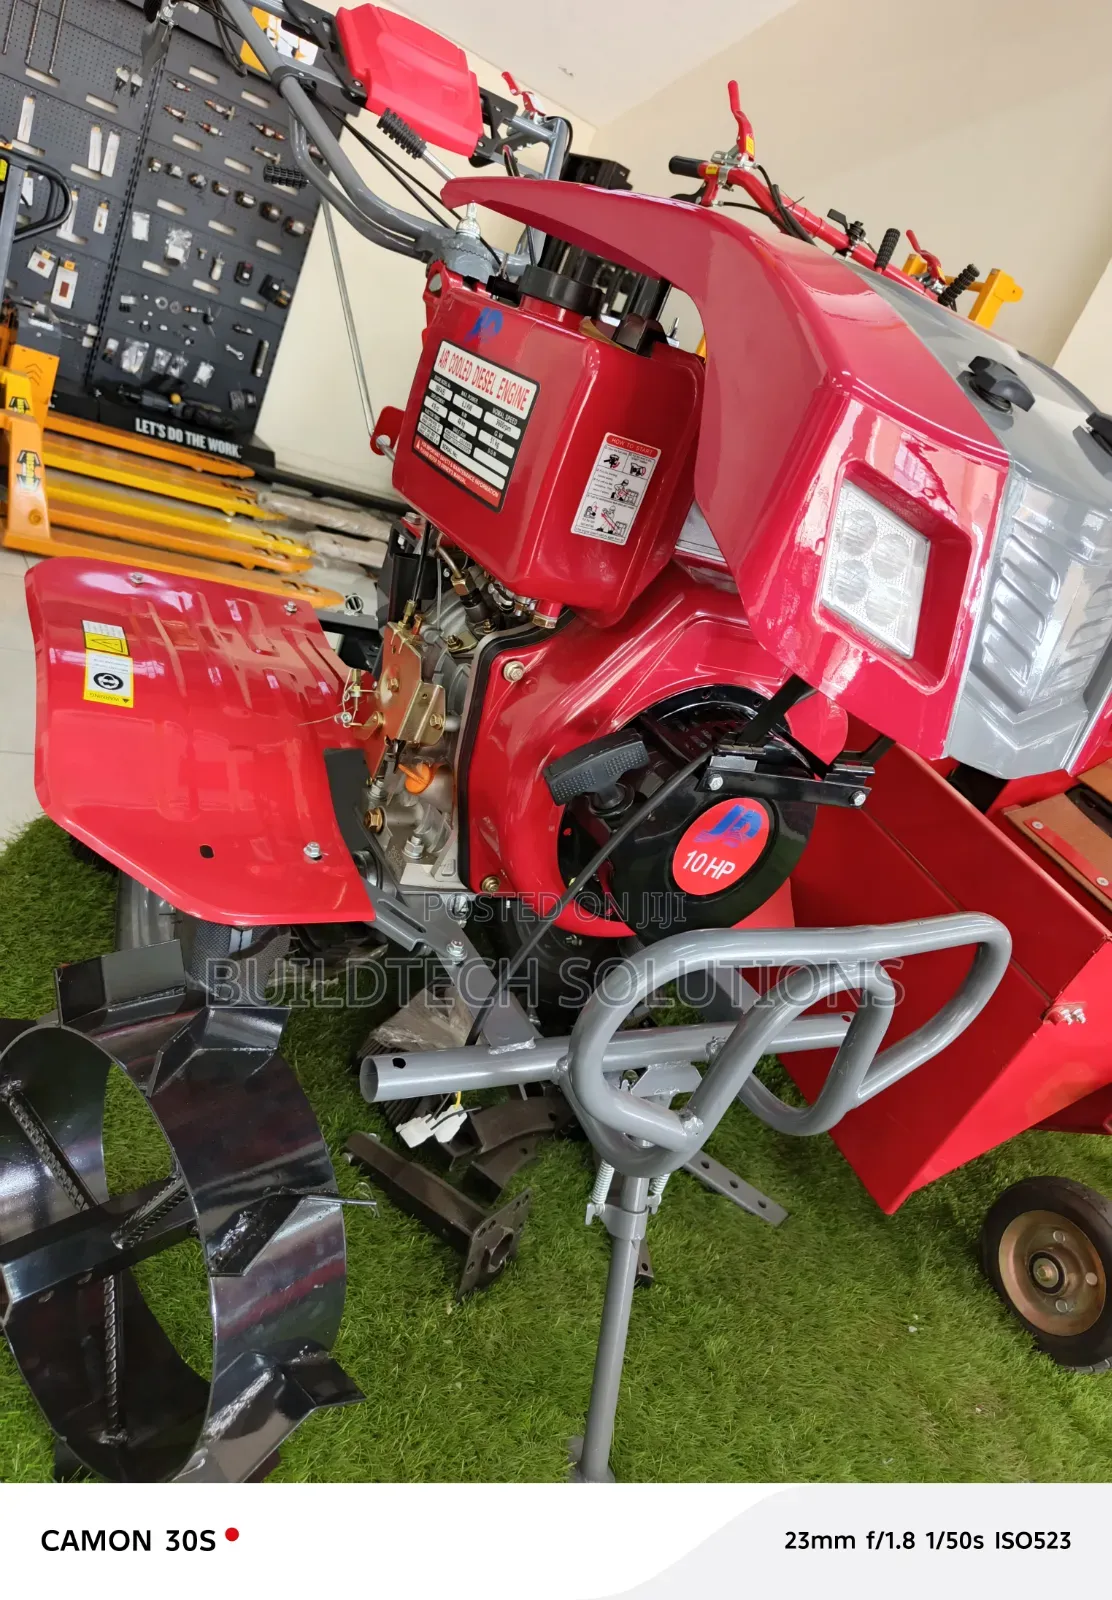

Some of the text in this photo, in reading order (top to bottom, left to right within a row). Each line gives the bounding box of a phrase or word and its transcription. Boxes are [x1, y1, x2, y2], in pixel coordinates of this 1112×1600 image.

[437, 347, 530, 412] AIR COOLED DIESEL ENGINE
[136, 418, 166, 438] LET'S
[167, 426, 183, 442] DO
[185, 431, 206, 449] THE
[611, 437, 626, 446] HOW
[636, 445, 654, 455] START
[683, 850, 736, 880] 10 HP
